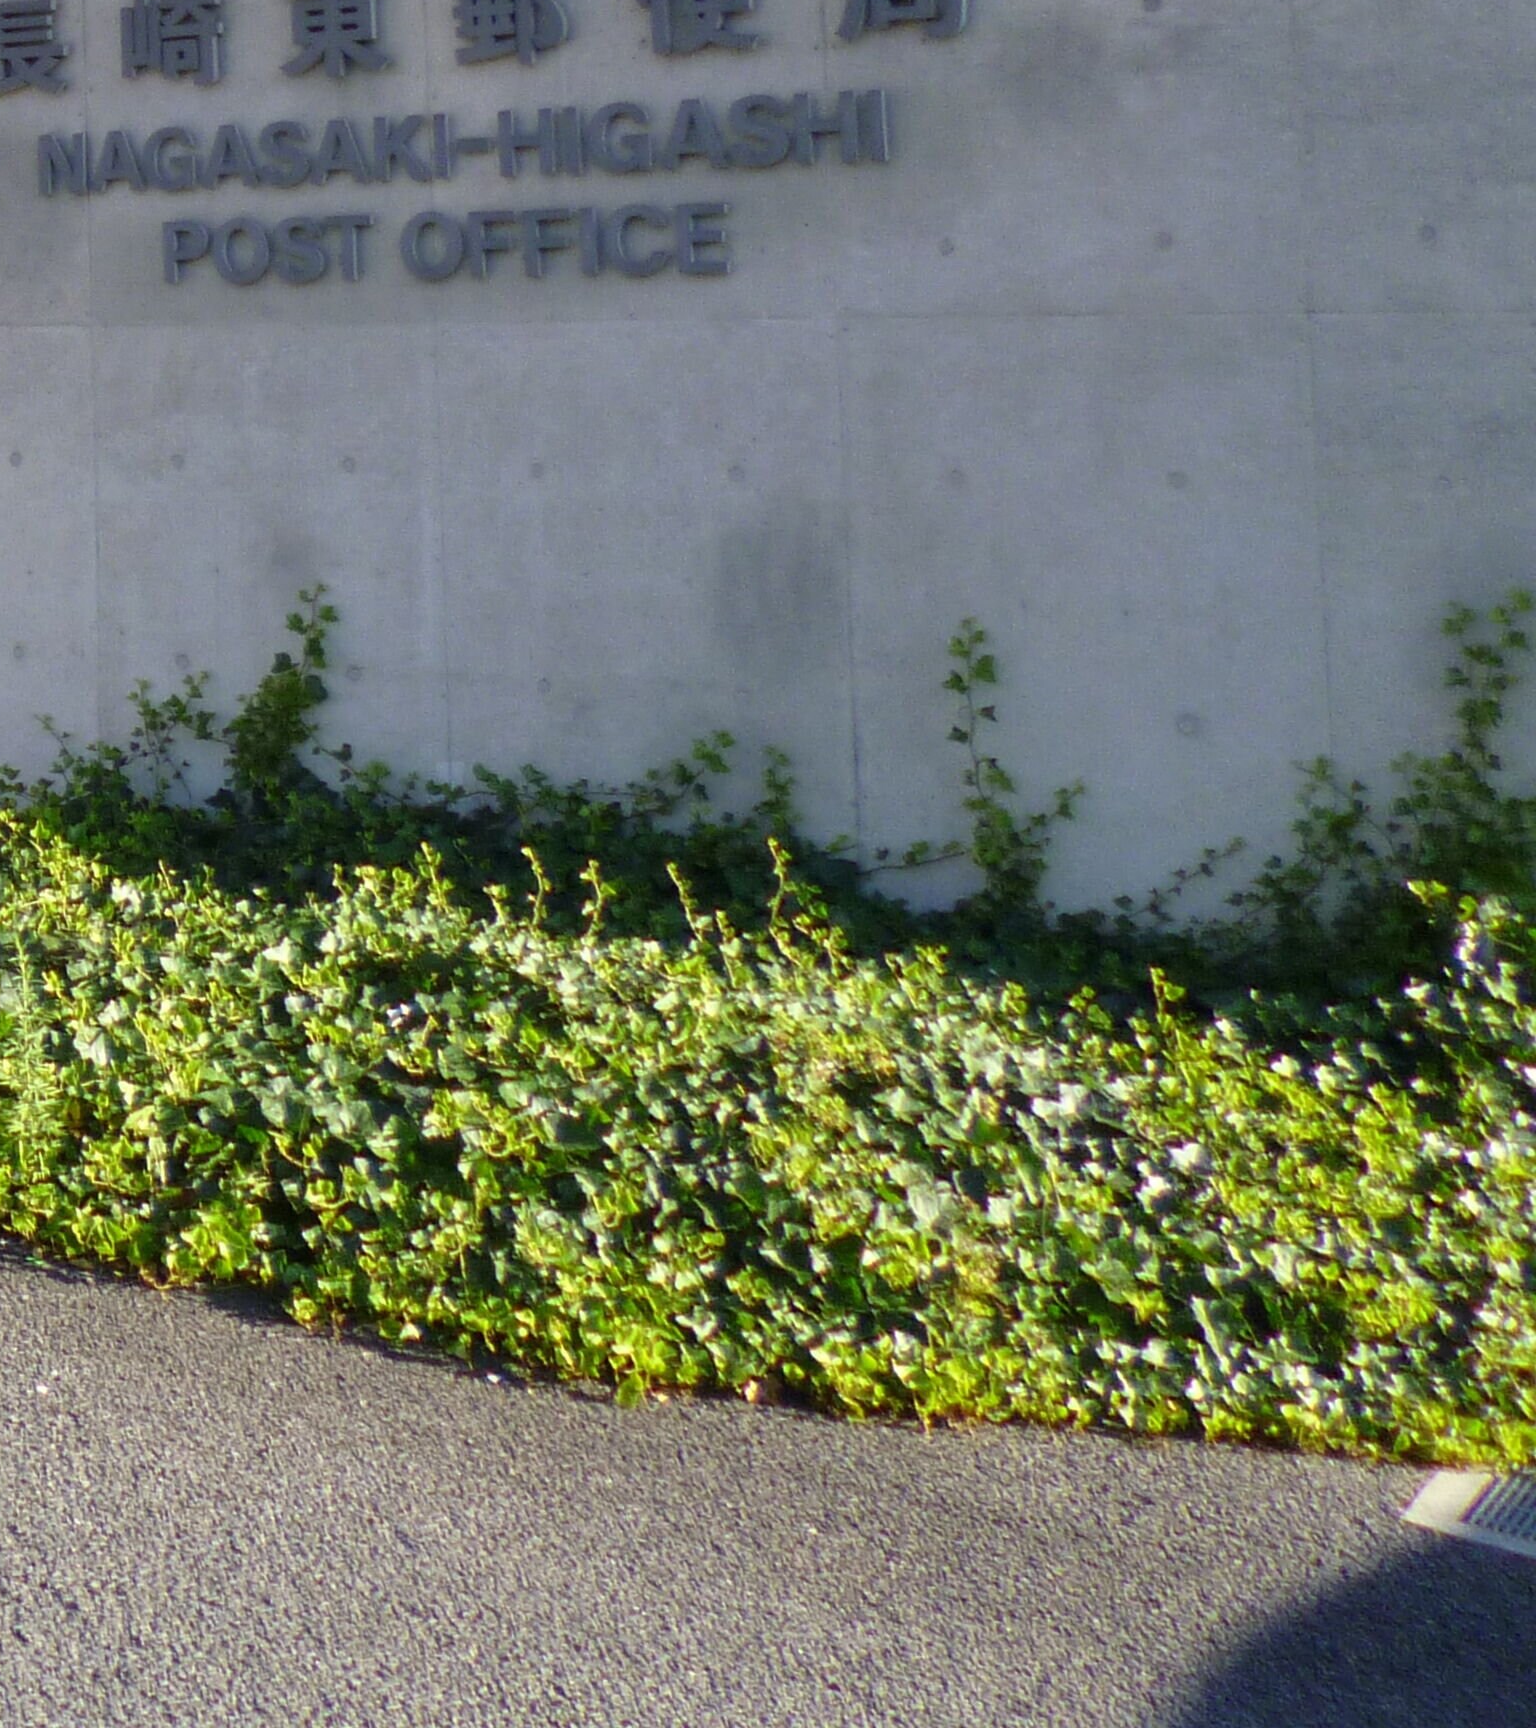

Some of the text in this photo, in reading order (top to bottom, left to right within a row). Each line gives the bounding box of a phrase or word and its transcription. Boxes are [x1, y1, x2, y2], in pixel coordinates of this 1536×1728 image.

[37, 88, 891, 197] NAGASAKI-HIGASHI
[161, 201, 731, 285] POST OFFICE
